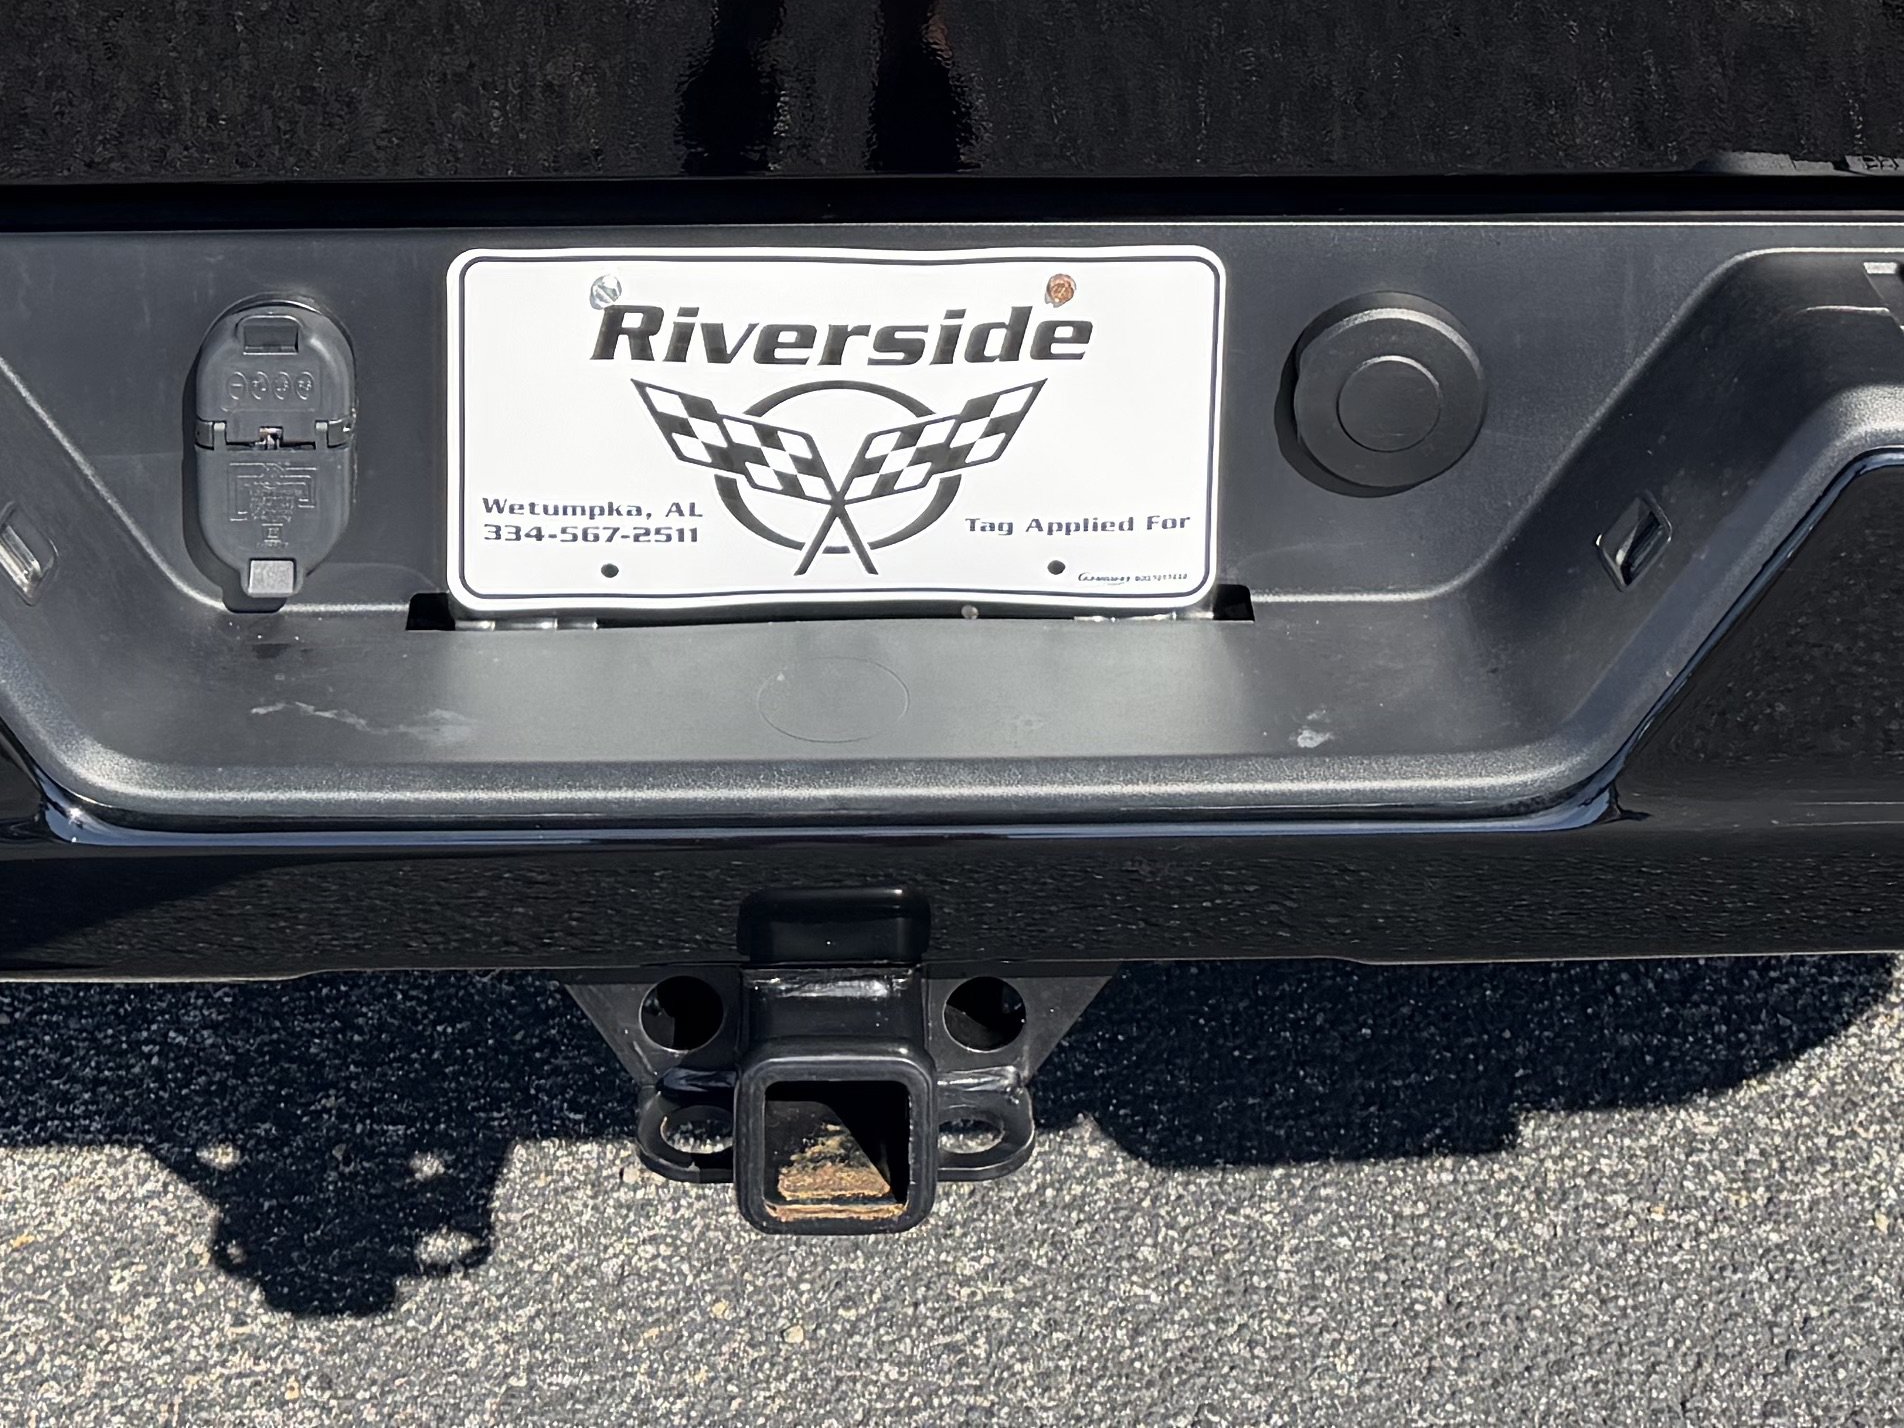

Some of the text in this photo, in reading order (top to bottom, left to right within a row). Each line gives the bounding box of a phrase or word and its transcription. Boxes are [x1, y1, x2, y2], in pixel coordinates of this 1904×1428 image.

[589, 305, 1094, 366] Riverside
[482, 497, 704, 520] Wetumpka, AL
[483, 523, 699, 543] 334-567-2511
[965, 515, 1192, 536] Tag Applied For
